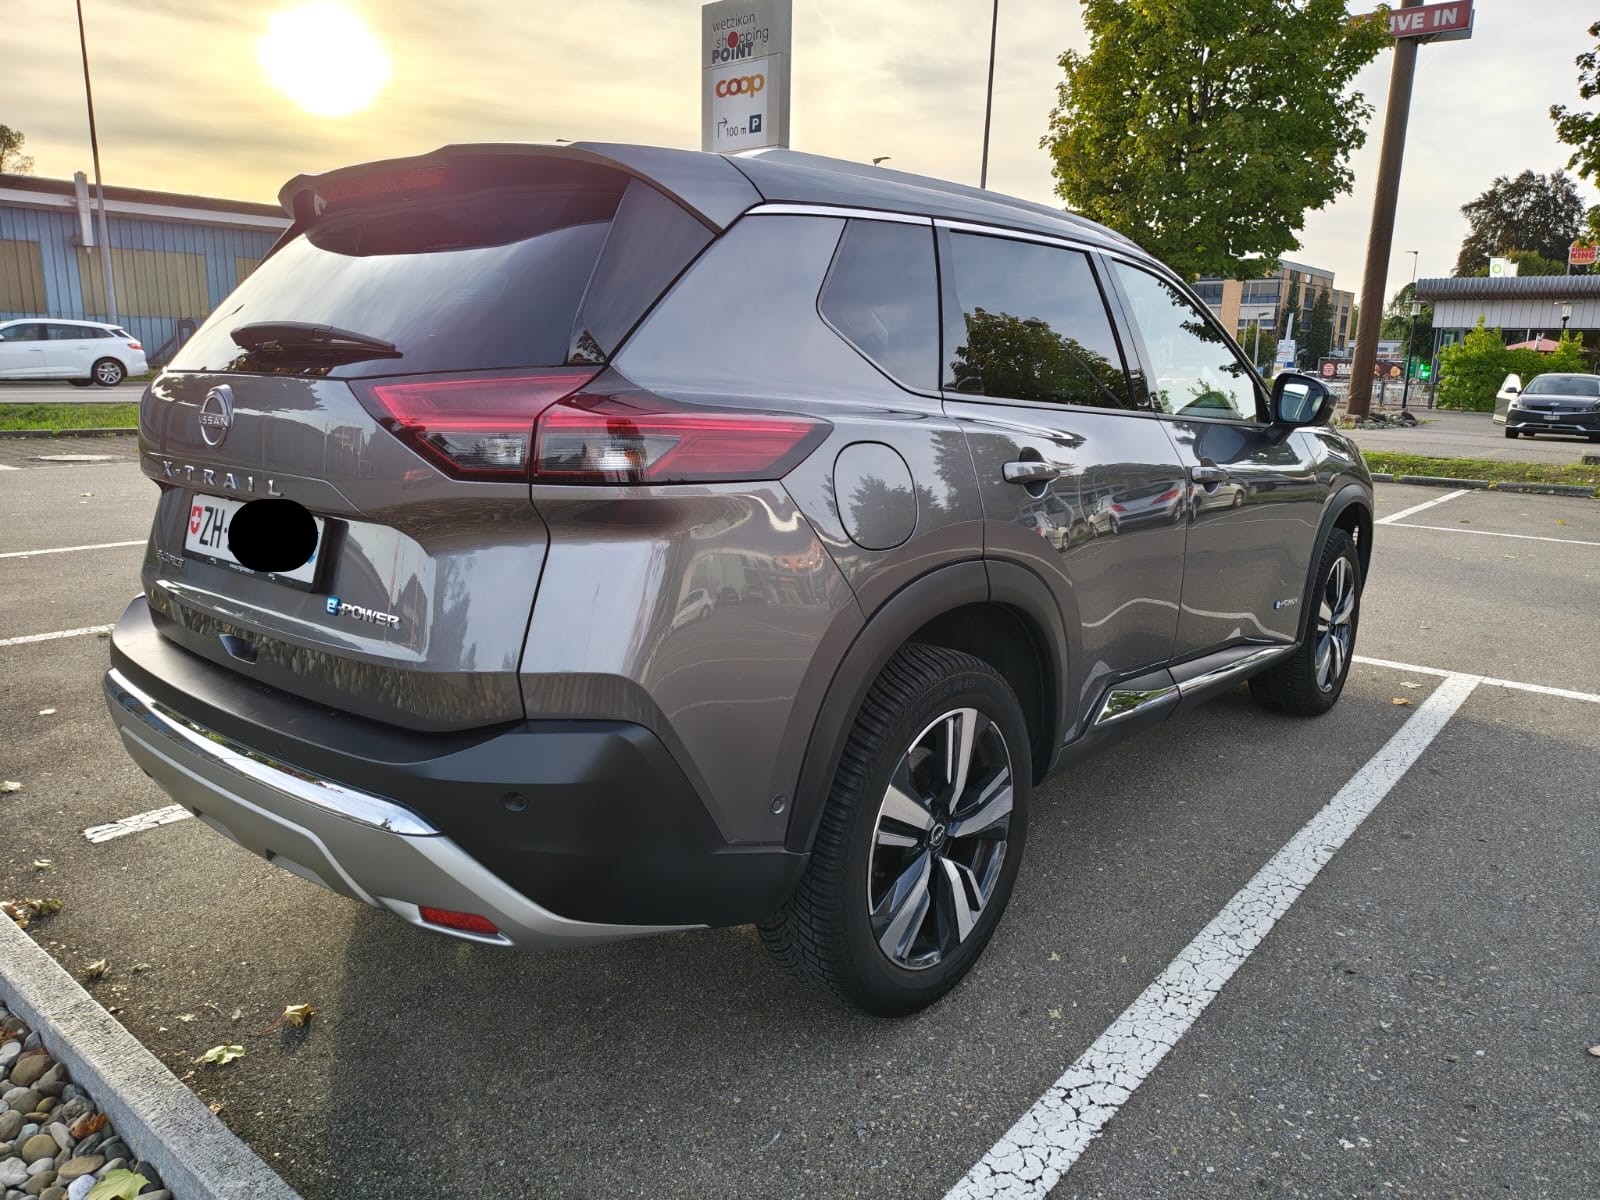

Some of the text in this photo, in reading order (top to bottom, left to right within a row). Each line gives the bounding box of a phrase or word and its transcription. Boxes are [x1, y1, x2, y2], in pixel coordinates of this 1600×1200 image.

[712, 13, 756, 32] wetzikon
[1389, 8, 1458, 32] IVE IN
[715, 73, 765, 98] coop
[726, 125, 739, 137] 100
[161, 459, 284, 497] X-TRAIL
